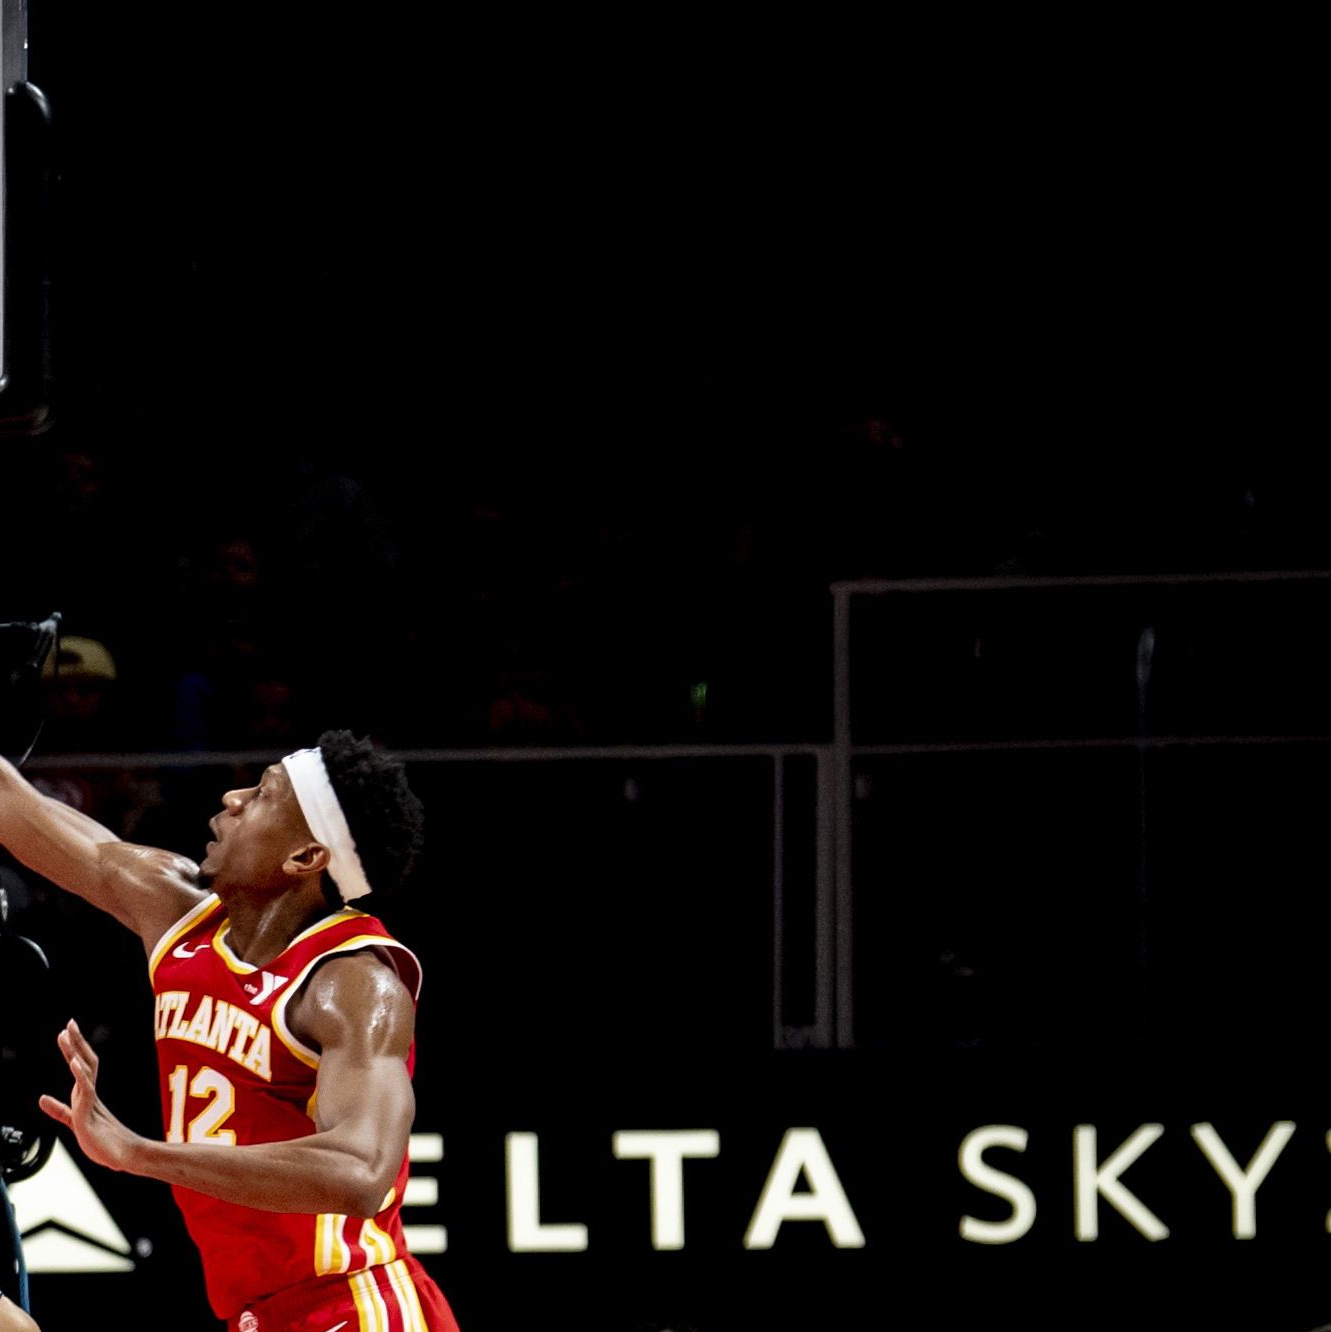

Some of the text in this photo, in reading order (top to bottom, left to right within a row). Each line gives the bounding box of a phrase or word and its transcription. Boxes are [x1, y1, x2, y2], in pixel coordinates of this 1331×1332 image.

[166, 1064, 237, 1147] 12
[403, 1119, 1331, 1253] ELTA SKY
